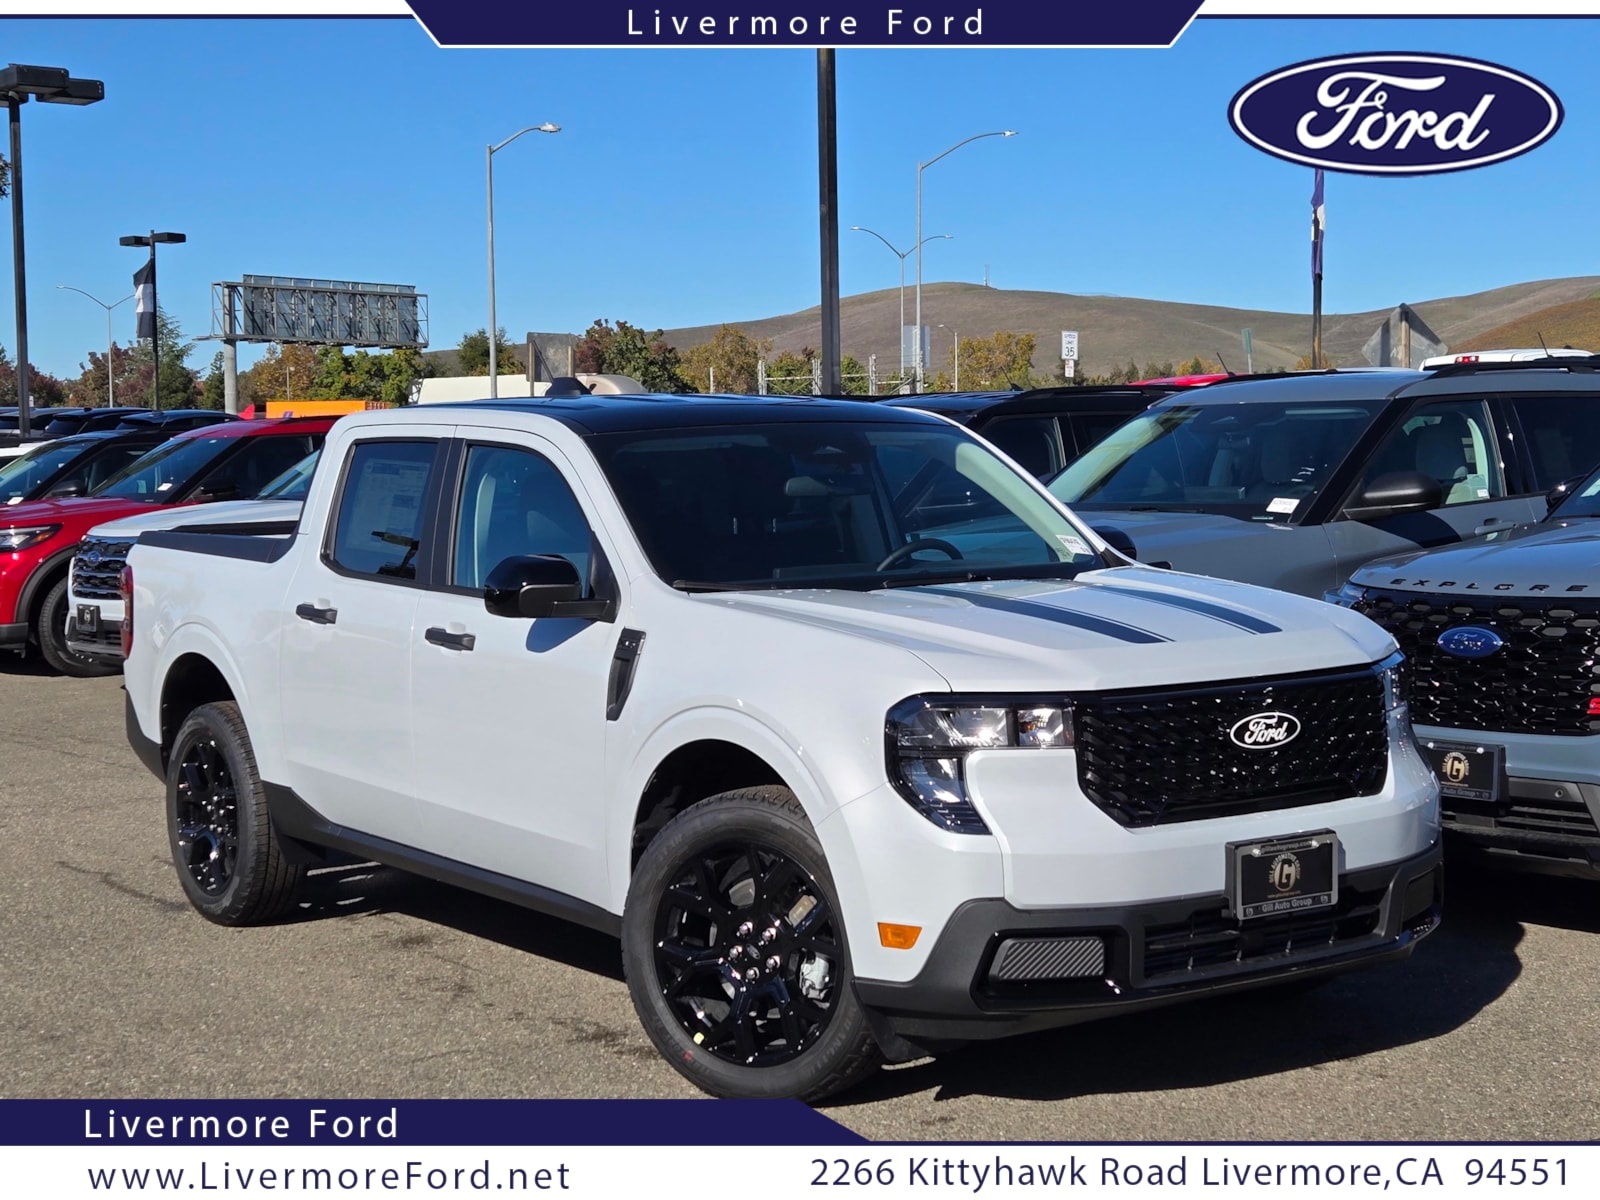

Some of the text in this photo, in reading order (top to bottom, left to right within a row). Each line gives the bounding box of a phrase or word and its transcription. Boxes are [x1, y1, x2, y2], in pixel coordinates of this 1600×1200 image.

[1064, 346, 1075, 357] 35
[1243, 718, 1289, 744] Ford
[1274, 901, 1290, 911] Auto
[1291, 898, 1313, 908] Group
